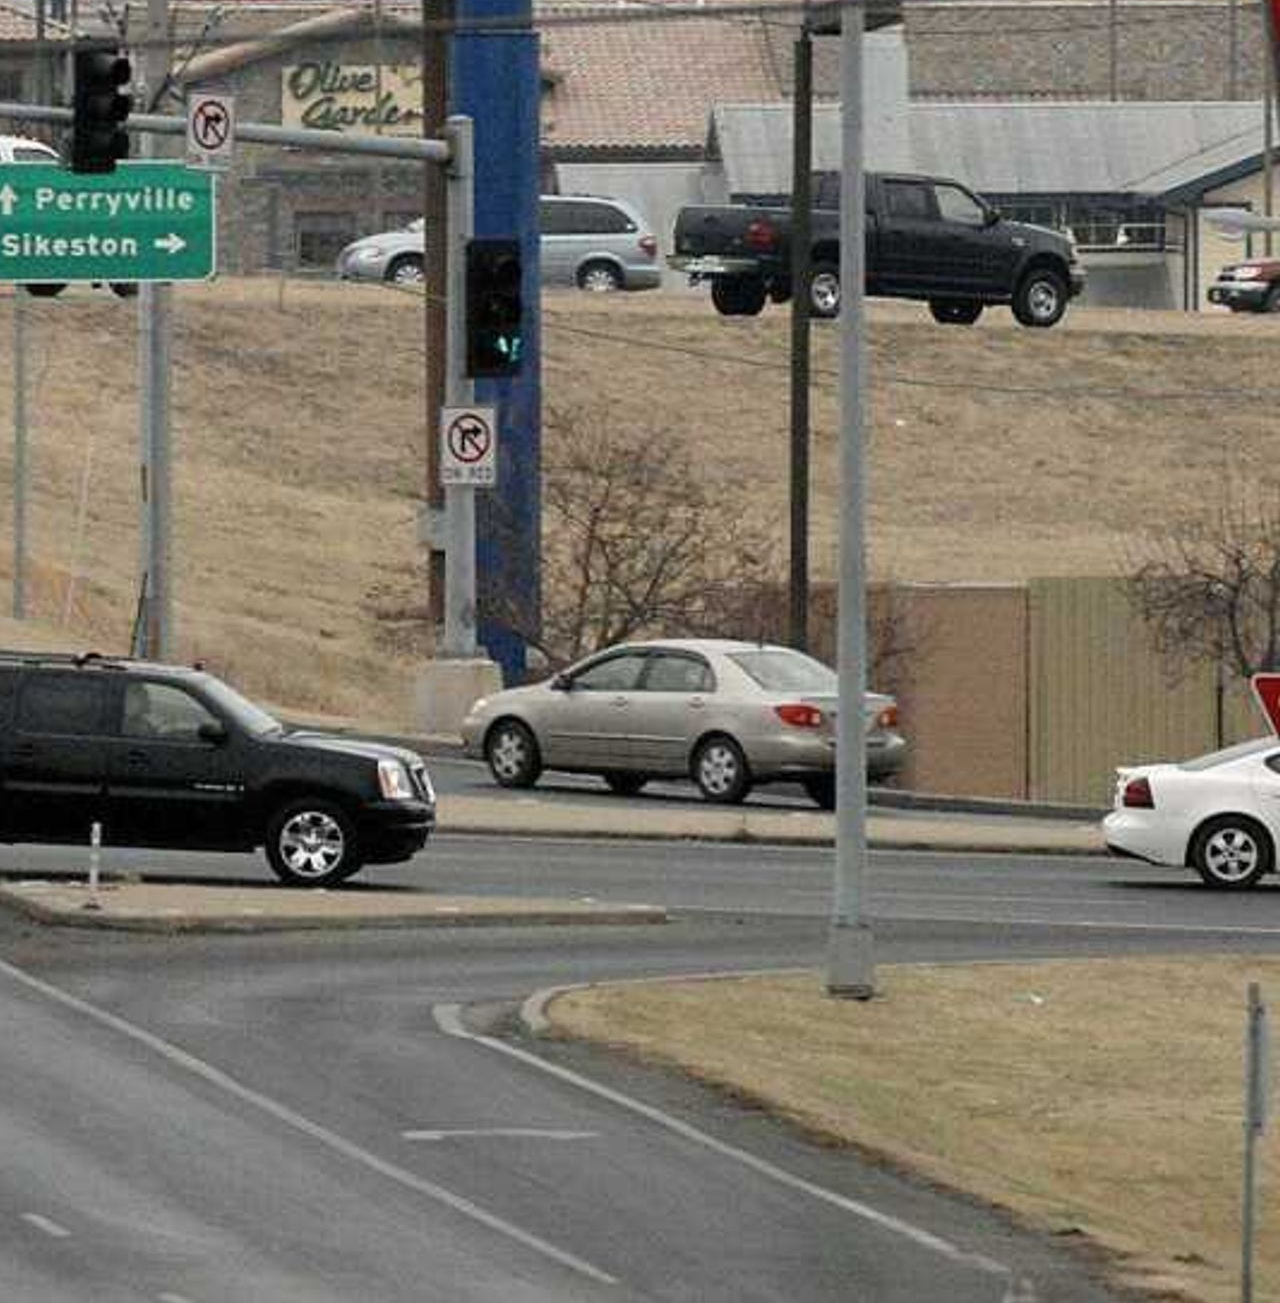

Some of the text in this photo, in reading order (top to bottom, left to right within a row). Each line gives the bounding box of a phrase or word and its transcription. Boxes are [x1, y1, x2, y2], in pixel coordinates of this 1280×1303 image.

[290, 60, 378, 100] Olive
[35, 186, 195, 216] Perryville
[0, 232, 139, 258] Sikeston
